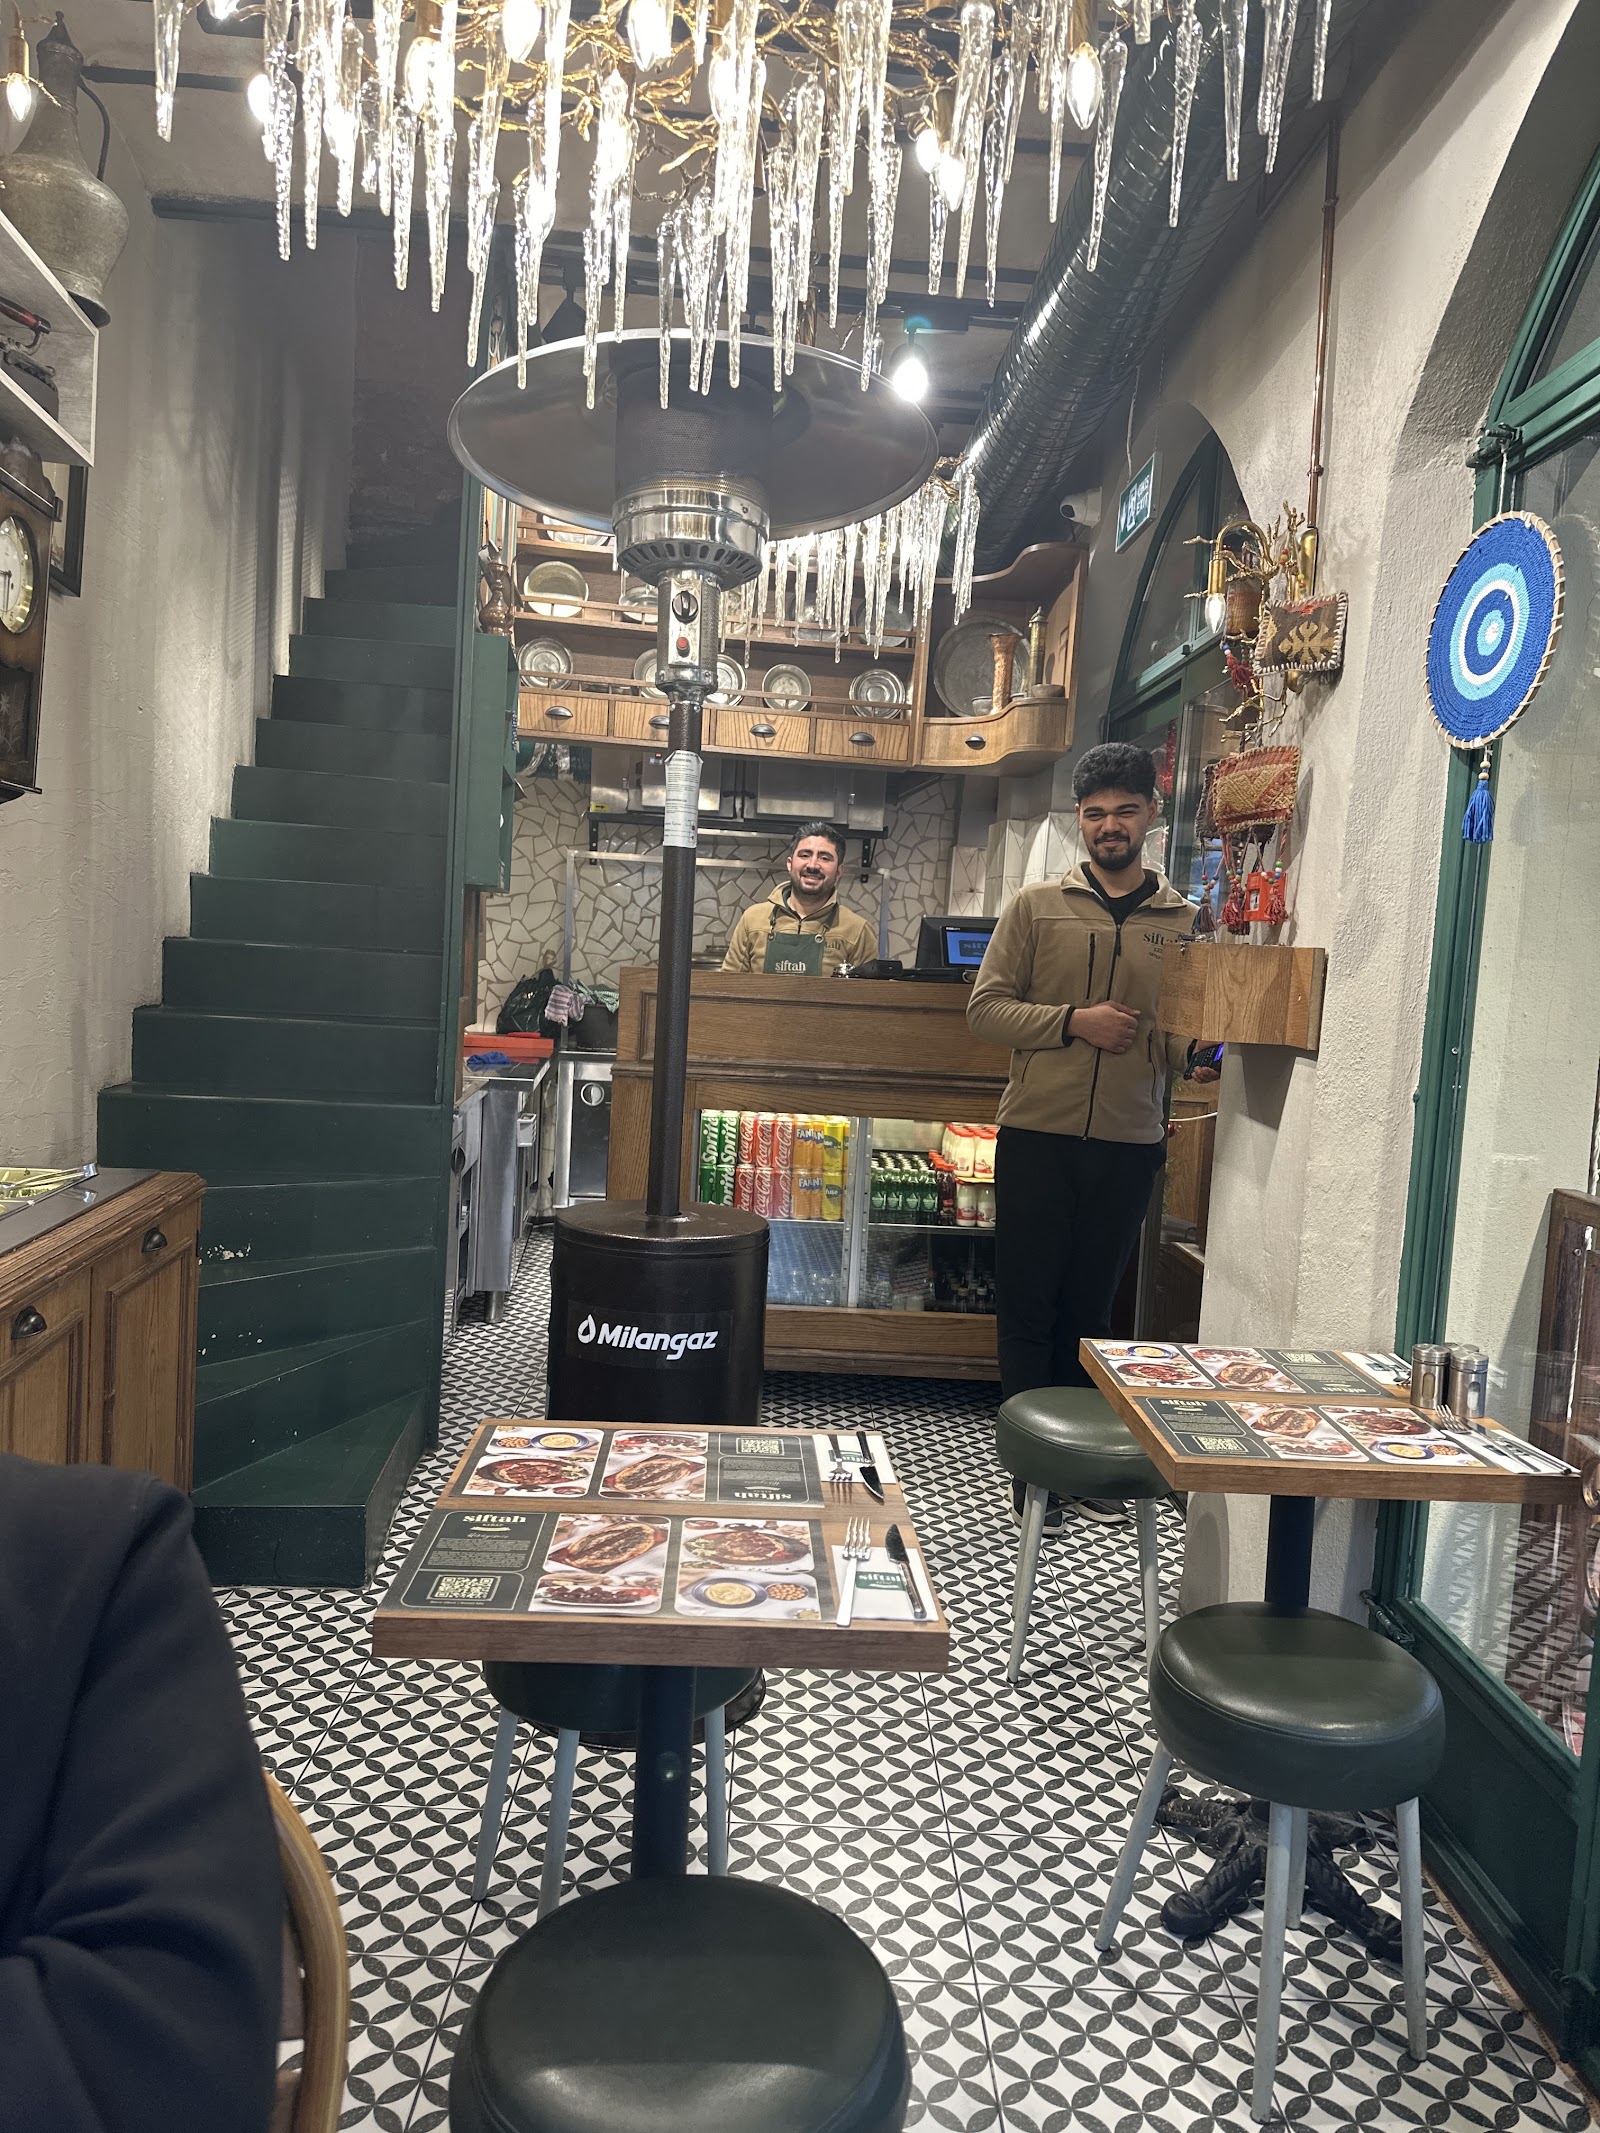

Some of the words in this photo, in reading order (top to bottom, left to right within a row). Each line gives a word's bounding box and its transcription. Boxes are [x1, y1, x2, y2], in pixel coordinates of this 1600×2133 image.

[1136, 491, 1149, 515] EXIT
[775, 960, 806, 971] siftah
[703, 1117, 719, 1164] Sprite
[720, 1116, 737, 1164] Sprite
[597, 1322, 719, 1361] Milangaz
[462, 1514, 527, 1523] siftah
